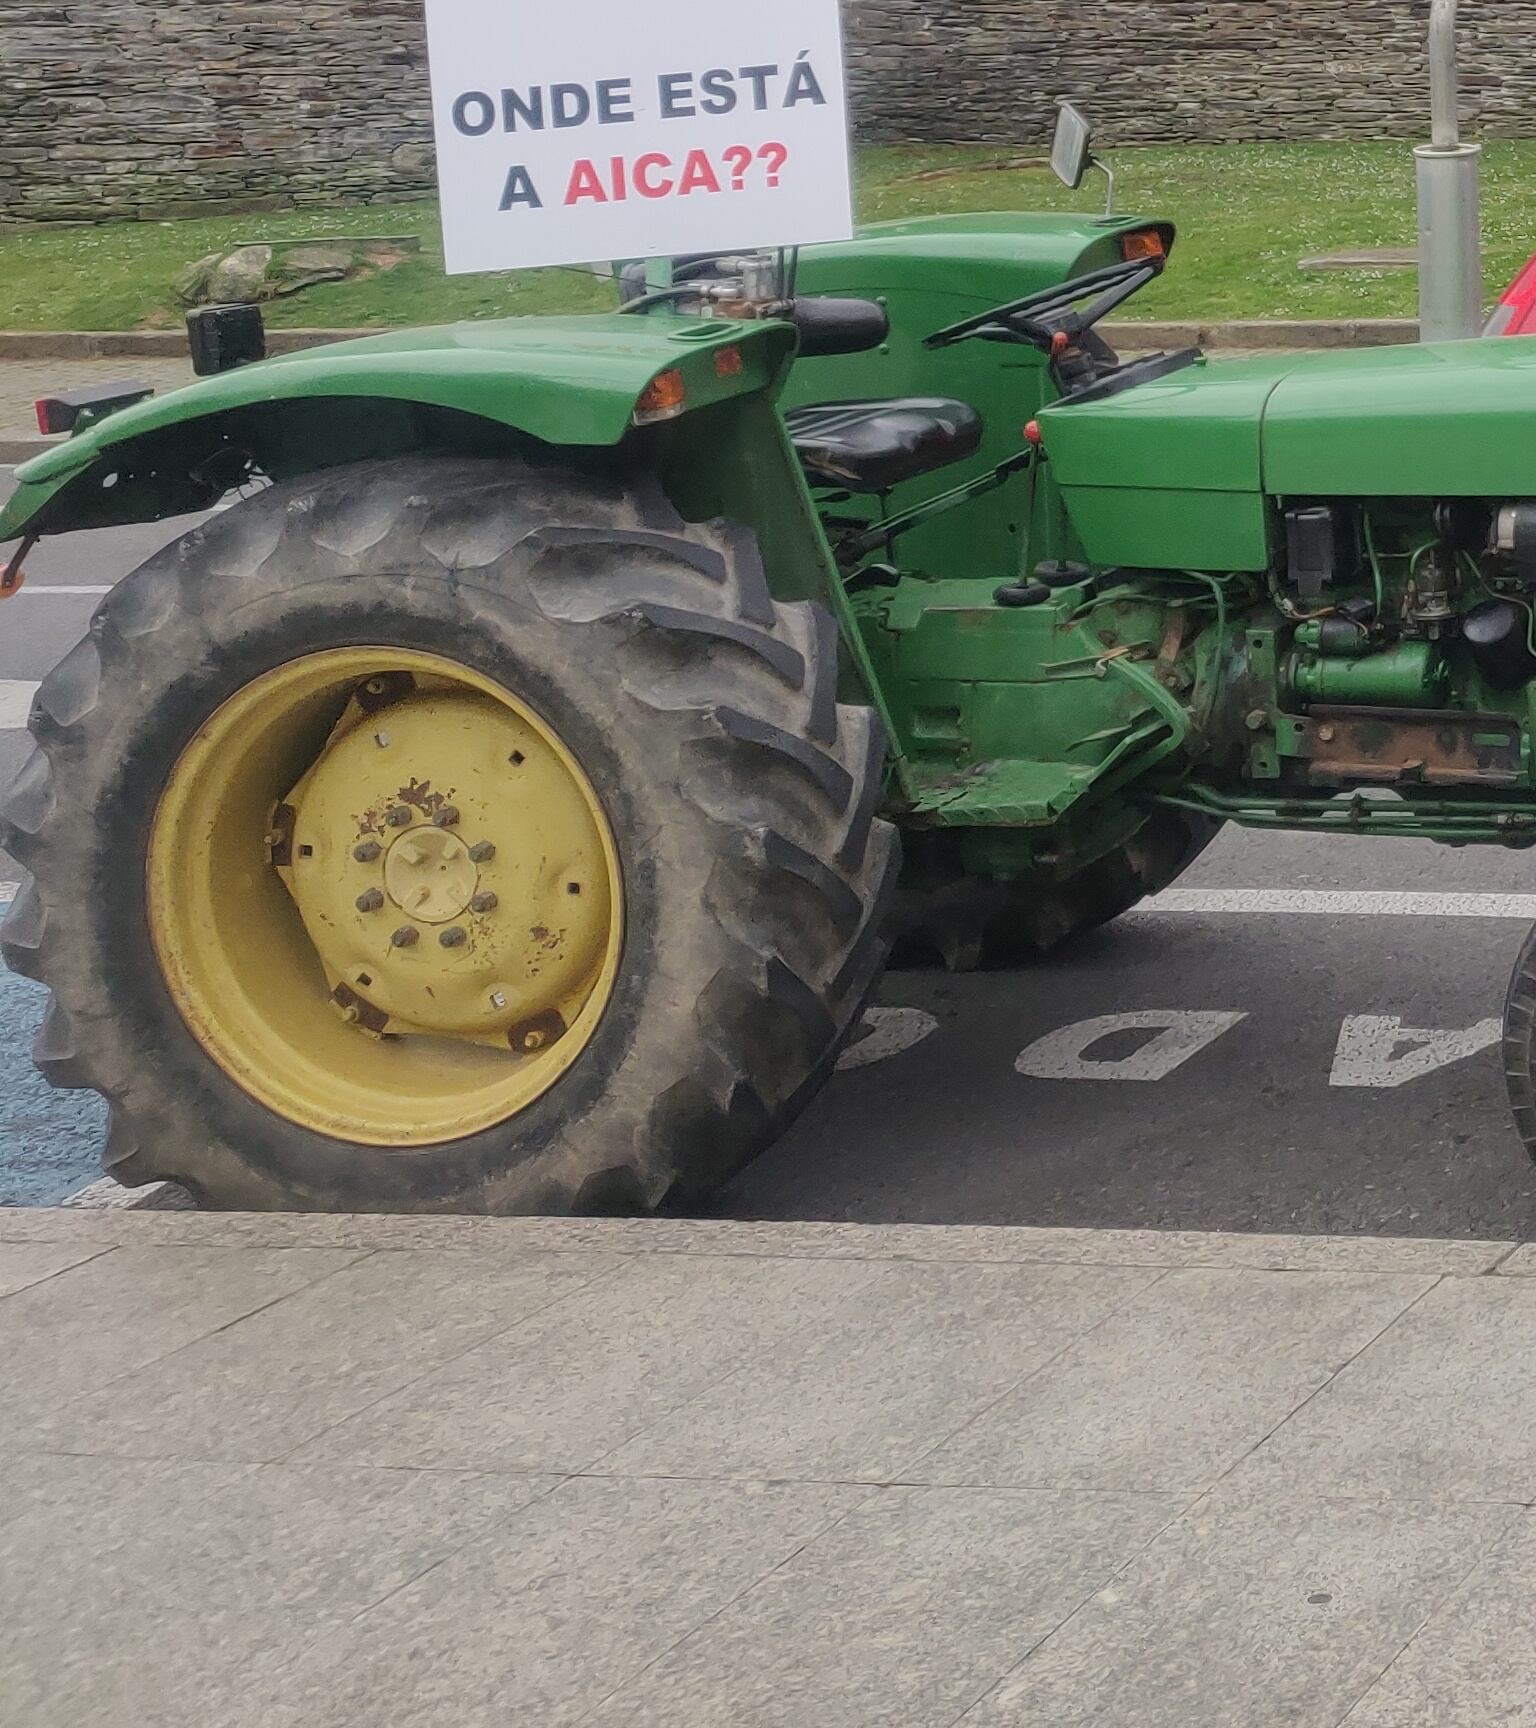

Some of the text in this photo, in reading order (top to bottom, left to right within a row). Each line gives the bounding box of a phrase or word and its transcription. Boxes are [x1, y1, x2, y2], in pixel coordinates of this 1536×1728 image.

[451, 49, 827, 137] ONDE ESTÁ
[498, 142, 788, 211] A AICA??
